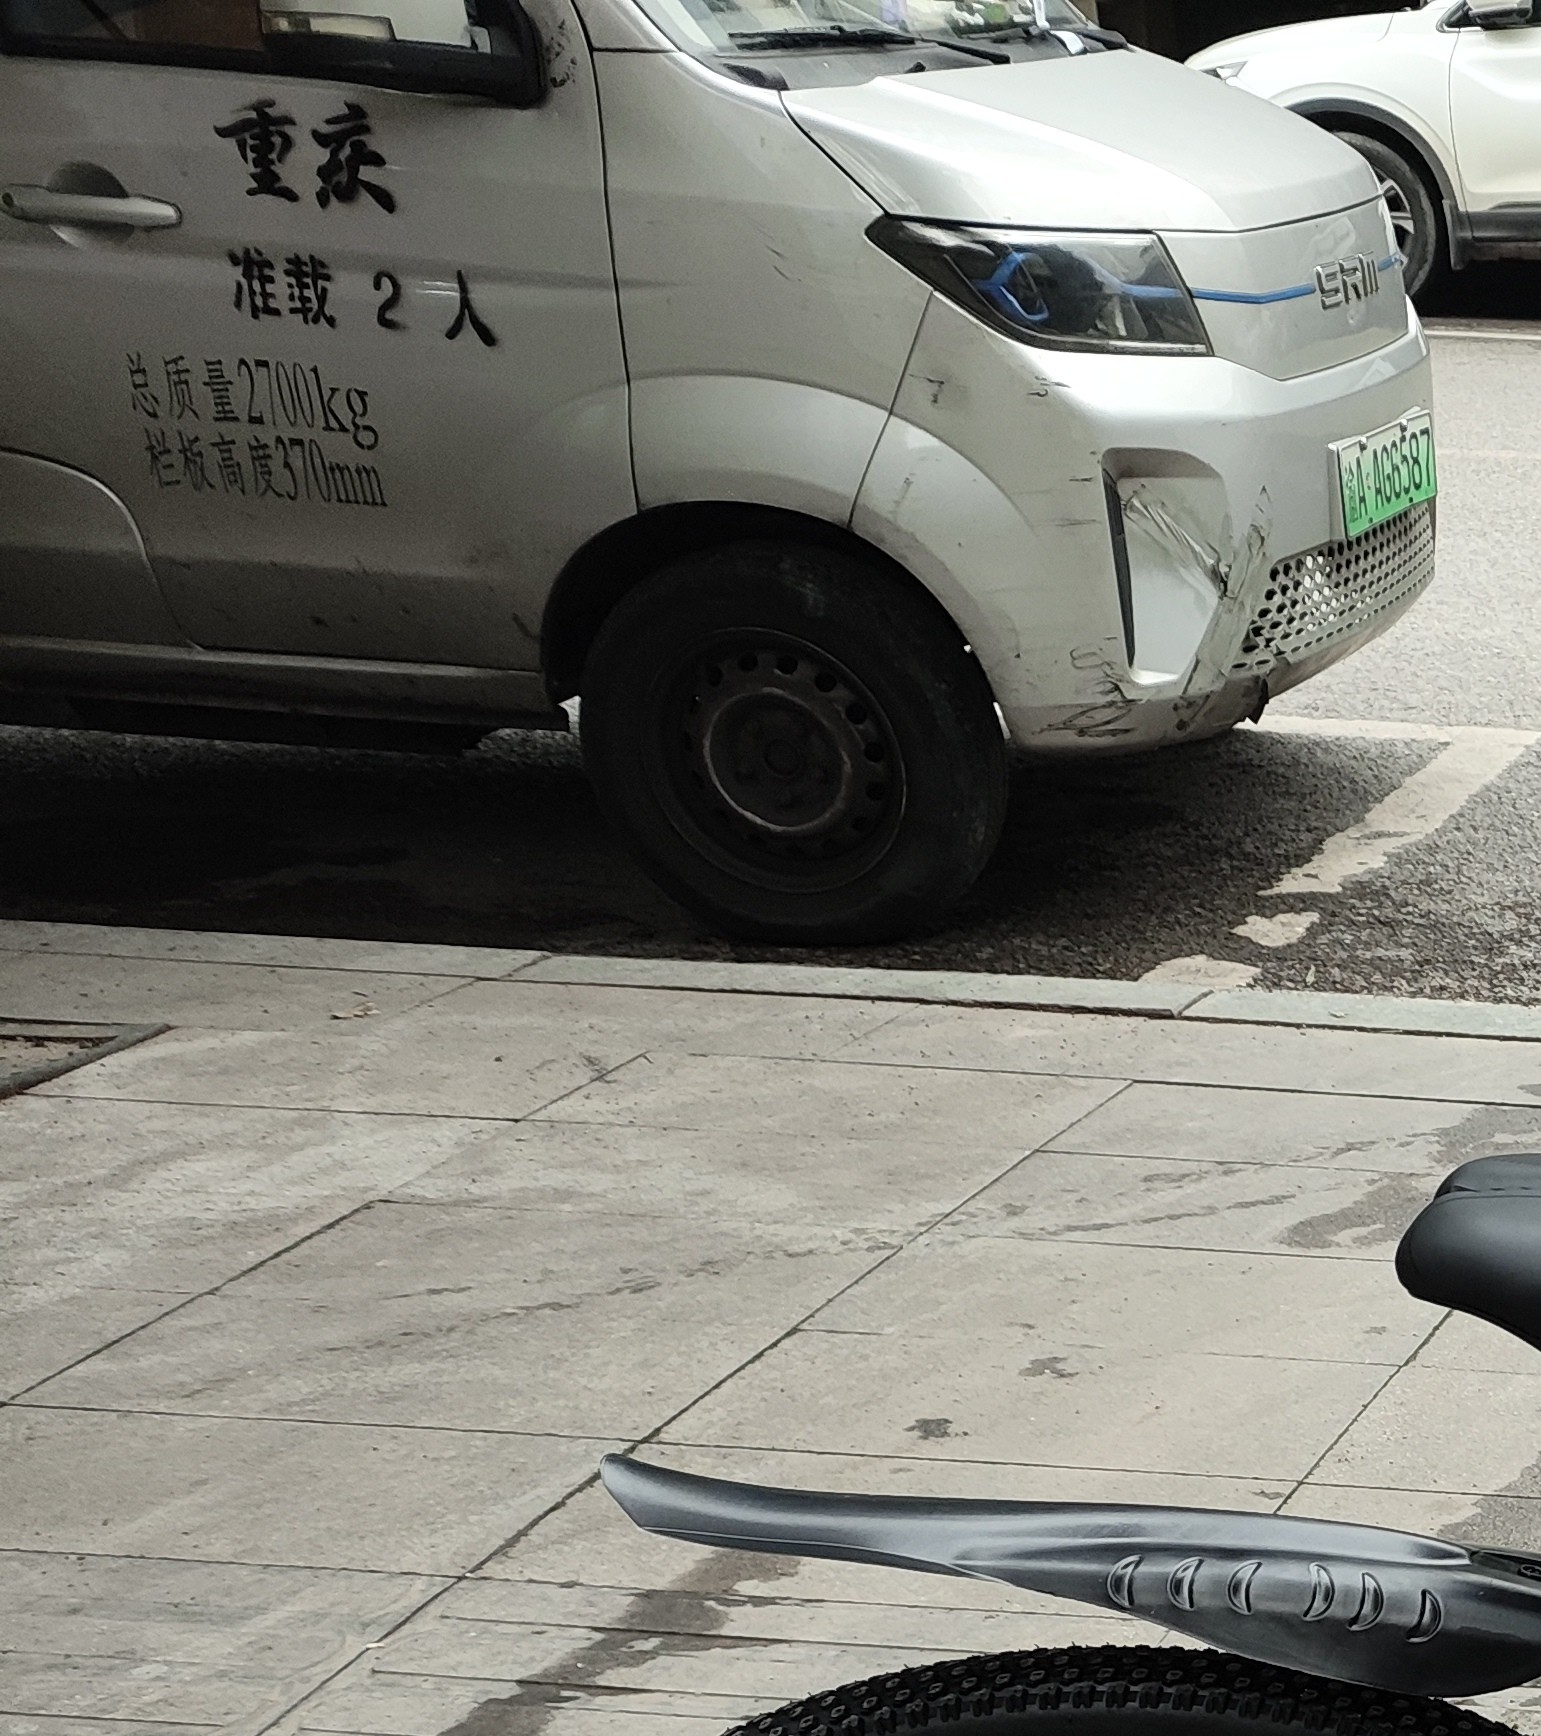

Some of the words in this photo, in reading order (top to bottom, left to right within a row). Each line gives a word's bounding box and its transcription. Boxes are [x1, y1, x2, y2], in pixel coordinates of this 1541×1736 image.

[213, 98, 396, 214] 重庆
[126, 351, 380, 451] 总质量2700kg
[144, 426, 389, 508] 栏板高度370mm
